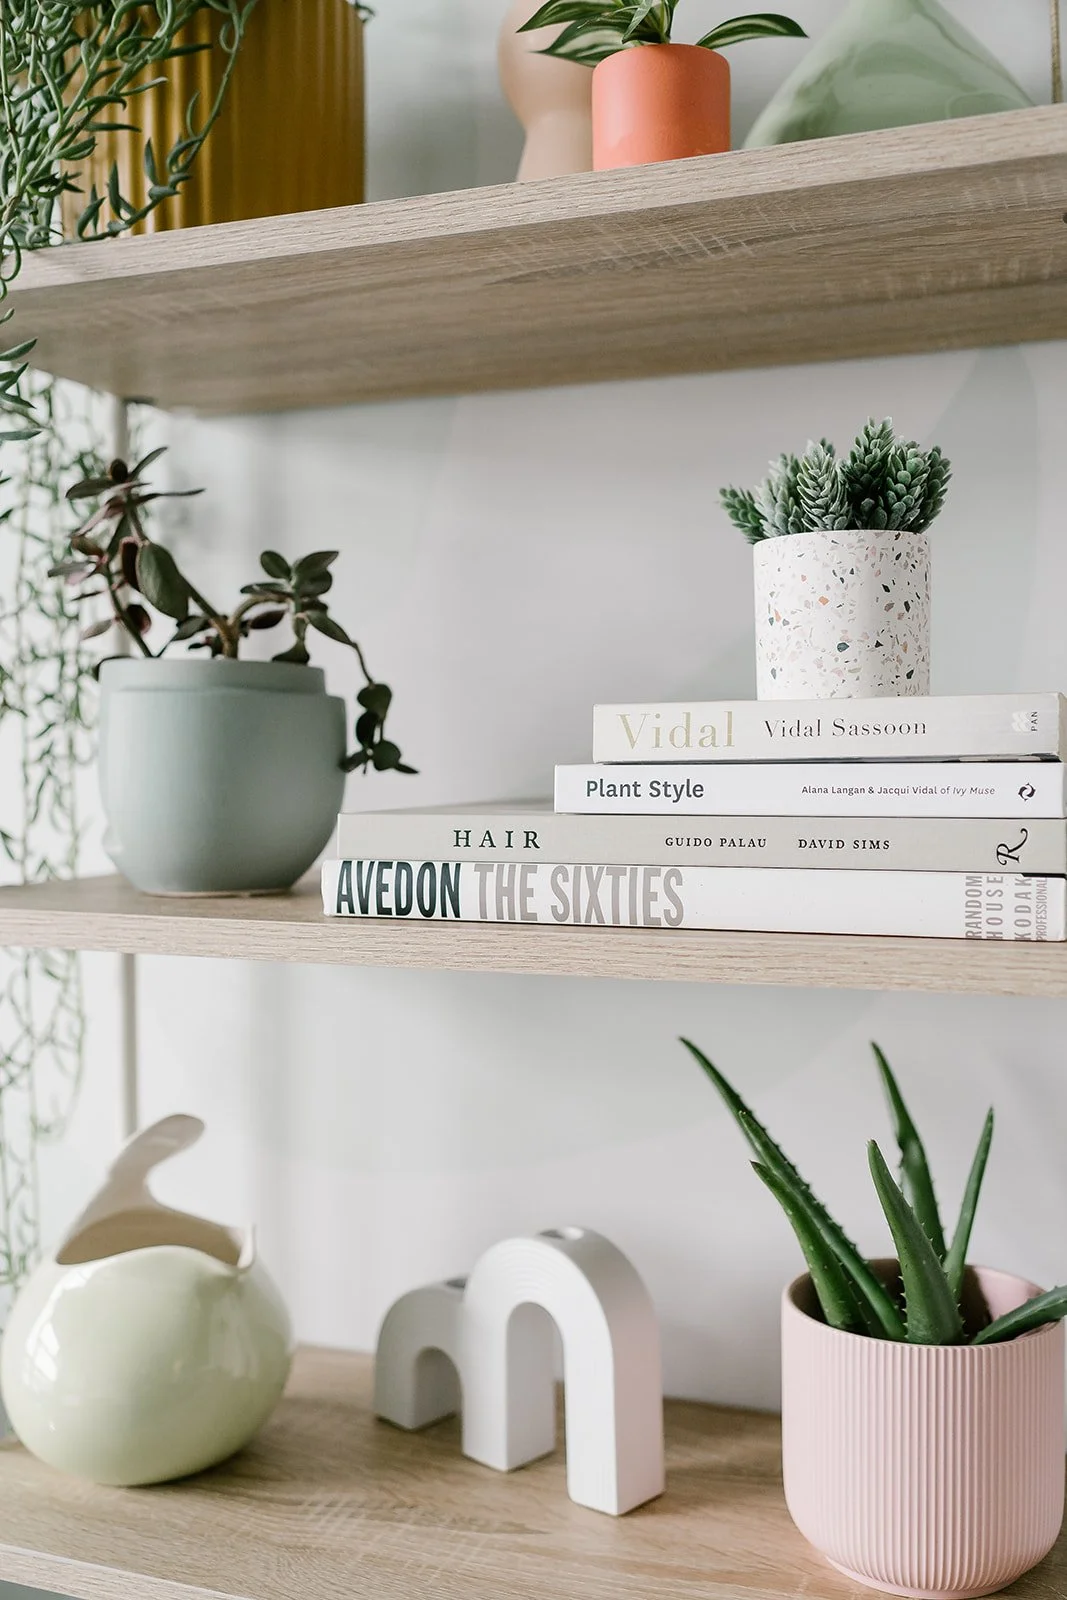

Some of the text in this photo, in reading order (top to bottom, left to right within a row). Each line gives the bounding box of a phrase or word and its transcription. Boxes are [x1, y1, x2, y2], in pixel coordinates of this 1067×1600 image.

[615, 710, 736, 750] Vidal
[764, 718, 928, 738] Vidal Sassoon
[1030, 711, 1039, 732] PAN
[587, 779, 704, 803] Plant Style
[801, 785, 997, 798] Alana Langan & Jacqui Vidal of Ivy Muse
[454, 830, 540, 848] HAIR
[666, 838, 766, 847] GUIDO PALAU
[799, 839, 889, 849] DAVID SIMS
[336, 861, 684, 926] AVEDON THE SIXTIES
[965, 876, 982, 939] RANDOM
[986, 876, 1004, 940] HOUSE
[1014, 877, 1032, 941] KODAK
[1036, 877, 1048, 941] PROFESSIONAL
